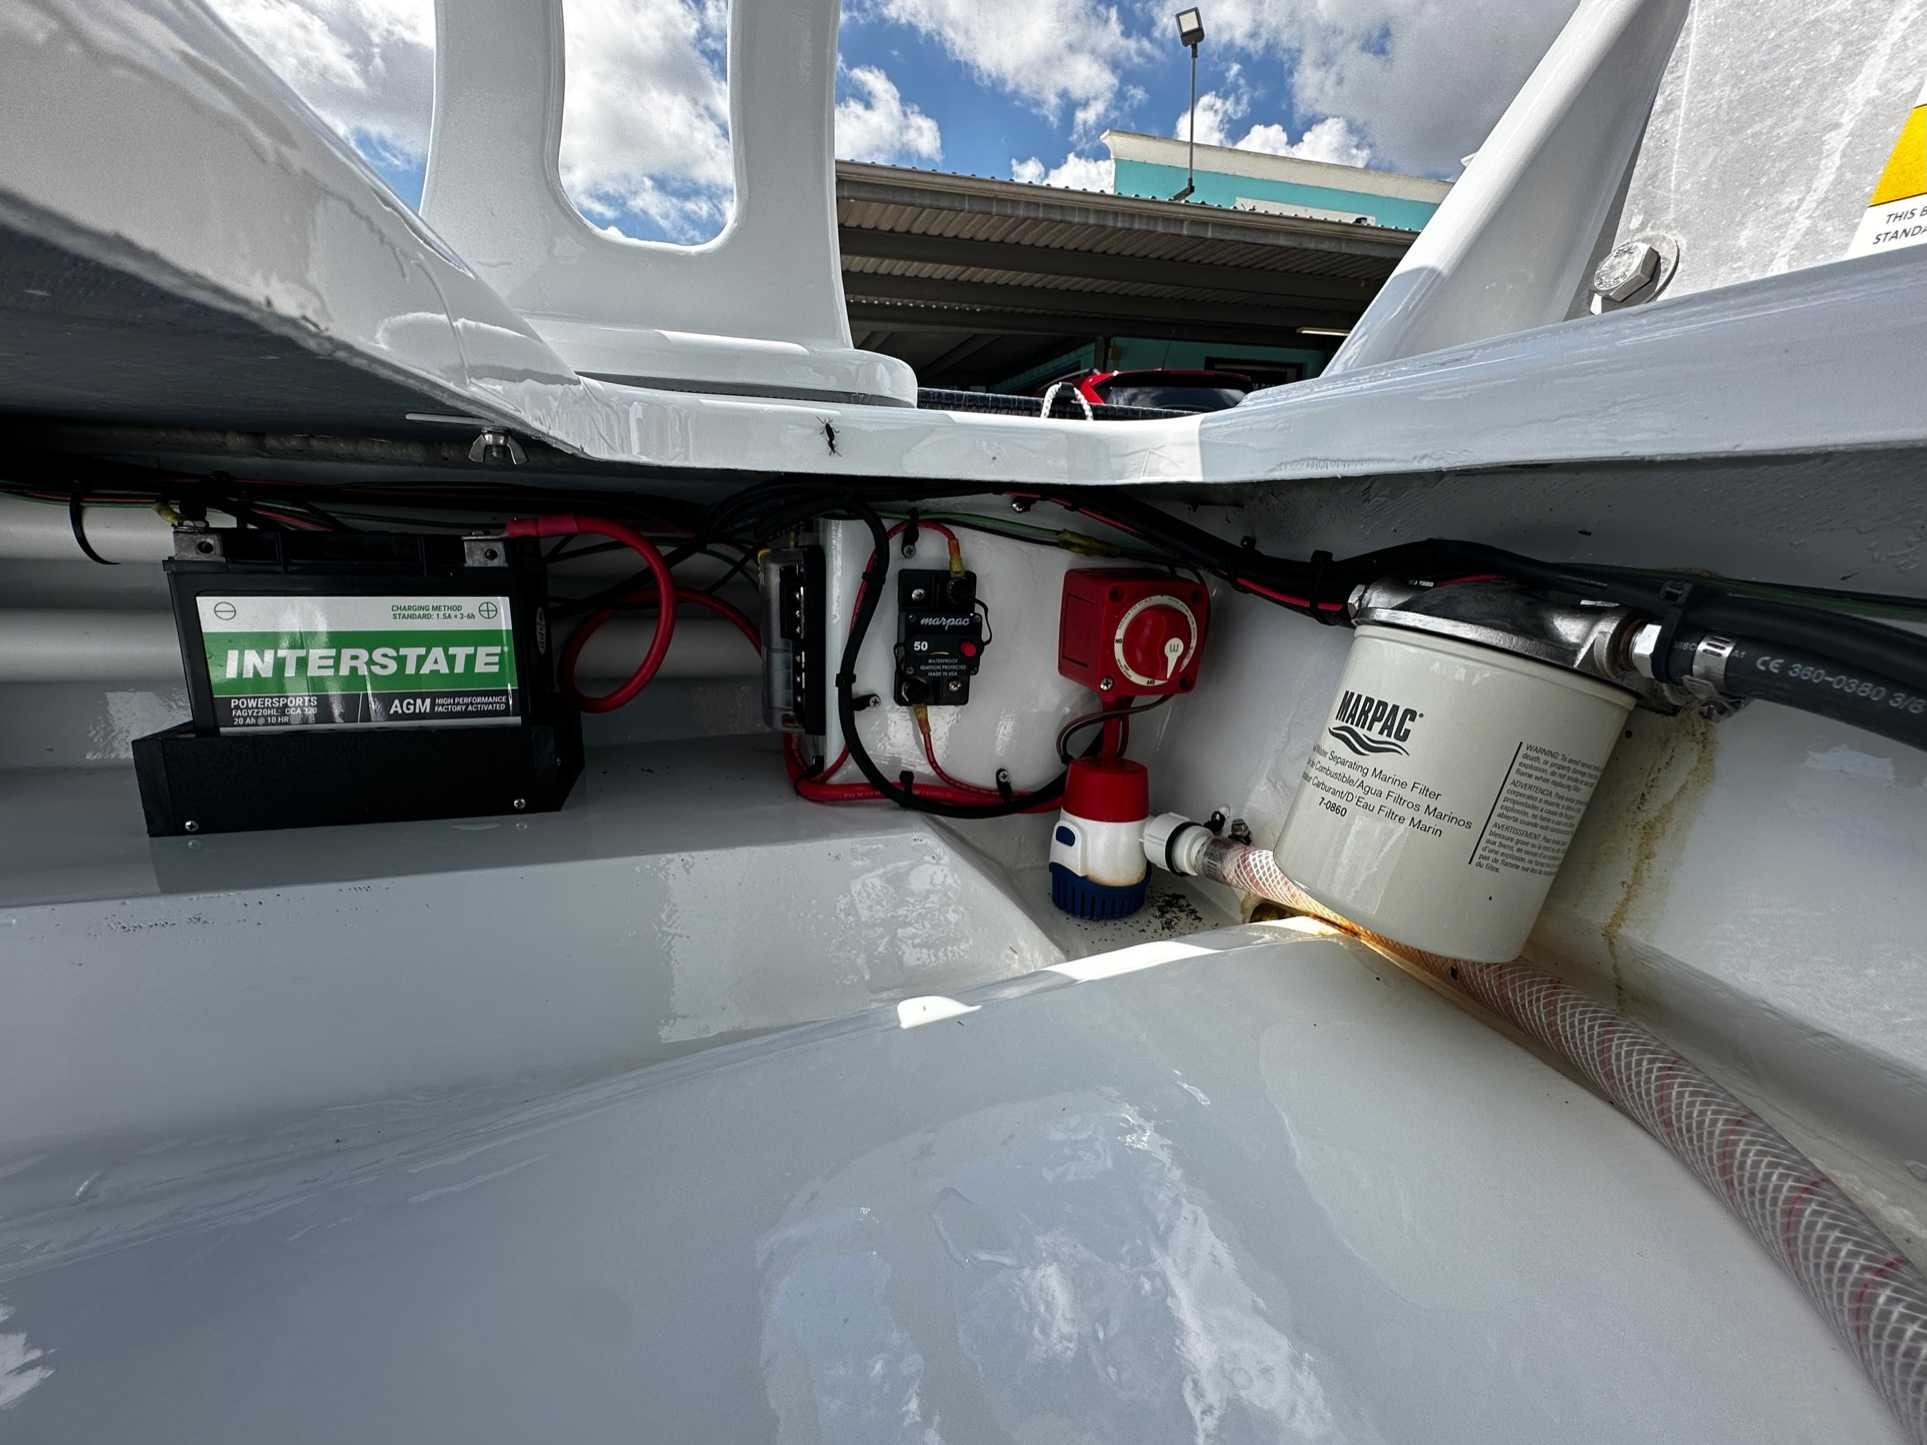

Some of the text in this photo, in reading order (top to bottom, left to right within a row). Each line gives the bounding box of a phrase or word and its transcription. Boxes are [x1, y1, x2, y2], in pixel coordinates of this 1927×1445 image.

[1886, 208, 1918, 224] THIS
[391, 604, 463, 612] CHARGING METHOD
[920, 616, 970, 631] marpac
[913, 640, 928, 651] 50
[225, 646, 502, 679] INTERSTATE
[1788, 663, 1886, 701] 360-0380
[230, 696, 318, 709] POWERSPORTS
[389, 698, 431, 714] AGM
[434, 703, 506, 713] FACTORY ACTIVATED
[435, 695, 507, 705] HIGH PERFORMANCE
[233, 717, 244, 725] 20
[245, 717, 256, 725] Ah
[1335, 690, 1418, 742] MARPAC
[1328, 750, 1370, 777] Separating
[1371, 767, 1408, 789] Marine
[1410, 781, 1442, 801] Filter
[1314, 760, 1383, 798] Combustible/Agua
[1385, 790, 1421, 812] Filtros
[1423, 804, 1473, 830] Marinos
[1311, 776, 1375, 812] Carburant/D'Eau
[1377, 804, 1406, 824] Filtre
[1408, 816, 1443, 838] Marin
[1318, 796, 1348, 817] 7-0860
